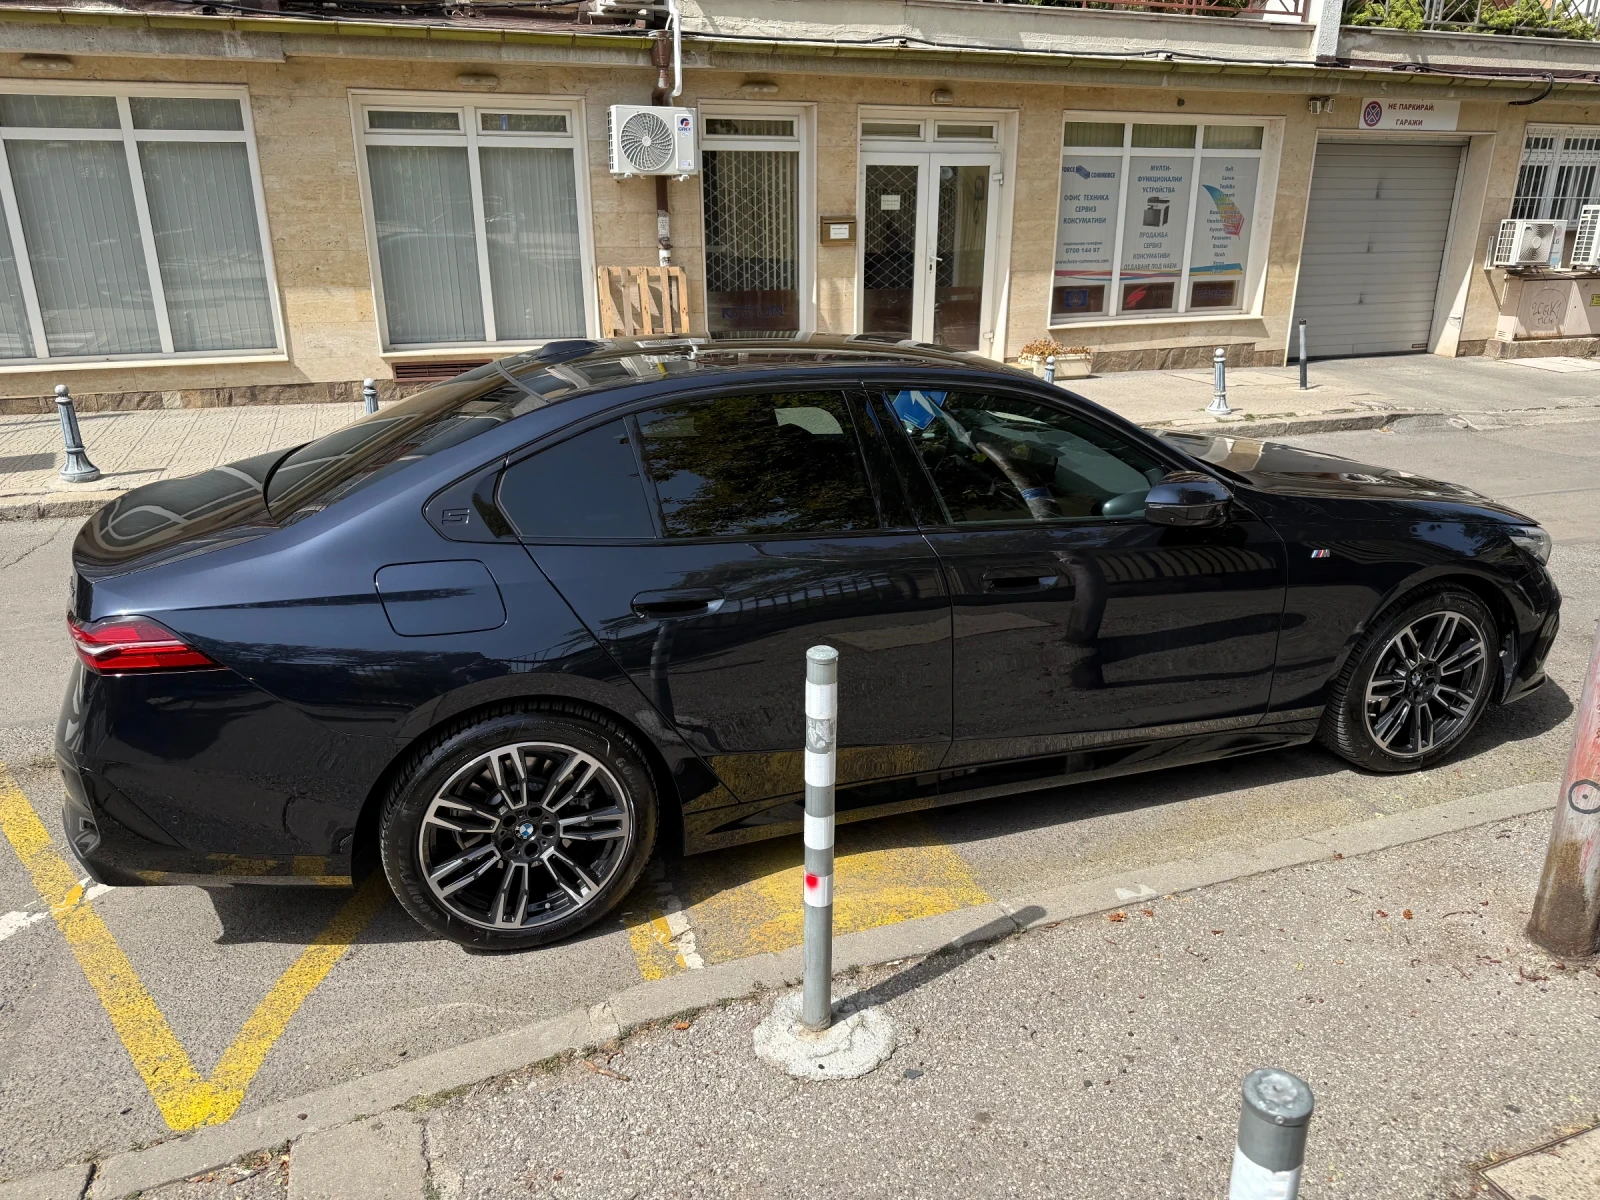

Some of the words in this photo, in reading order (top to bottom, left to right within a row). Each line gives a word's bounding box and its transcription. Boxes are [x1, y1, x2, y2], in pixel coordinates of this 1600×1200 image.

[1395, 118, 1423, 126] ГАРАЖИ
[1063, 217, 1107, 225] КОНСУМАТИВИ
[1139, 231, 1168, 239] ПРОДАЖБА
[1132, 252, 1171, 260] КОНСУМАТИВИ
[1124, 263, 1150, 271] ОТДАВАНЕ
